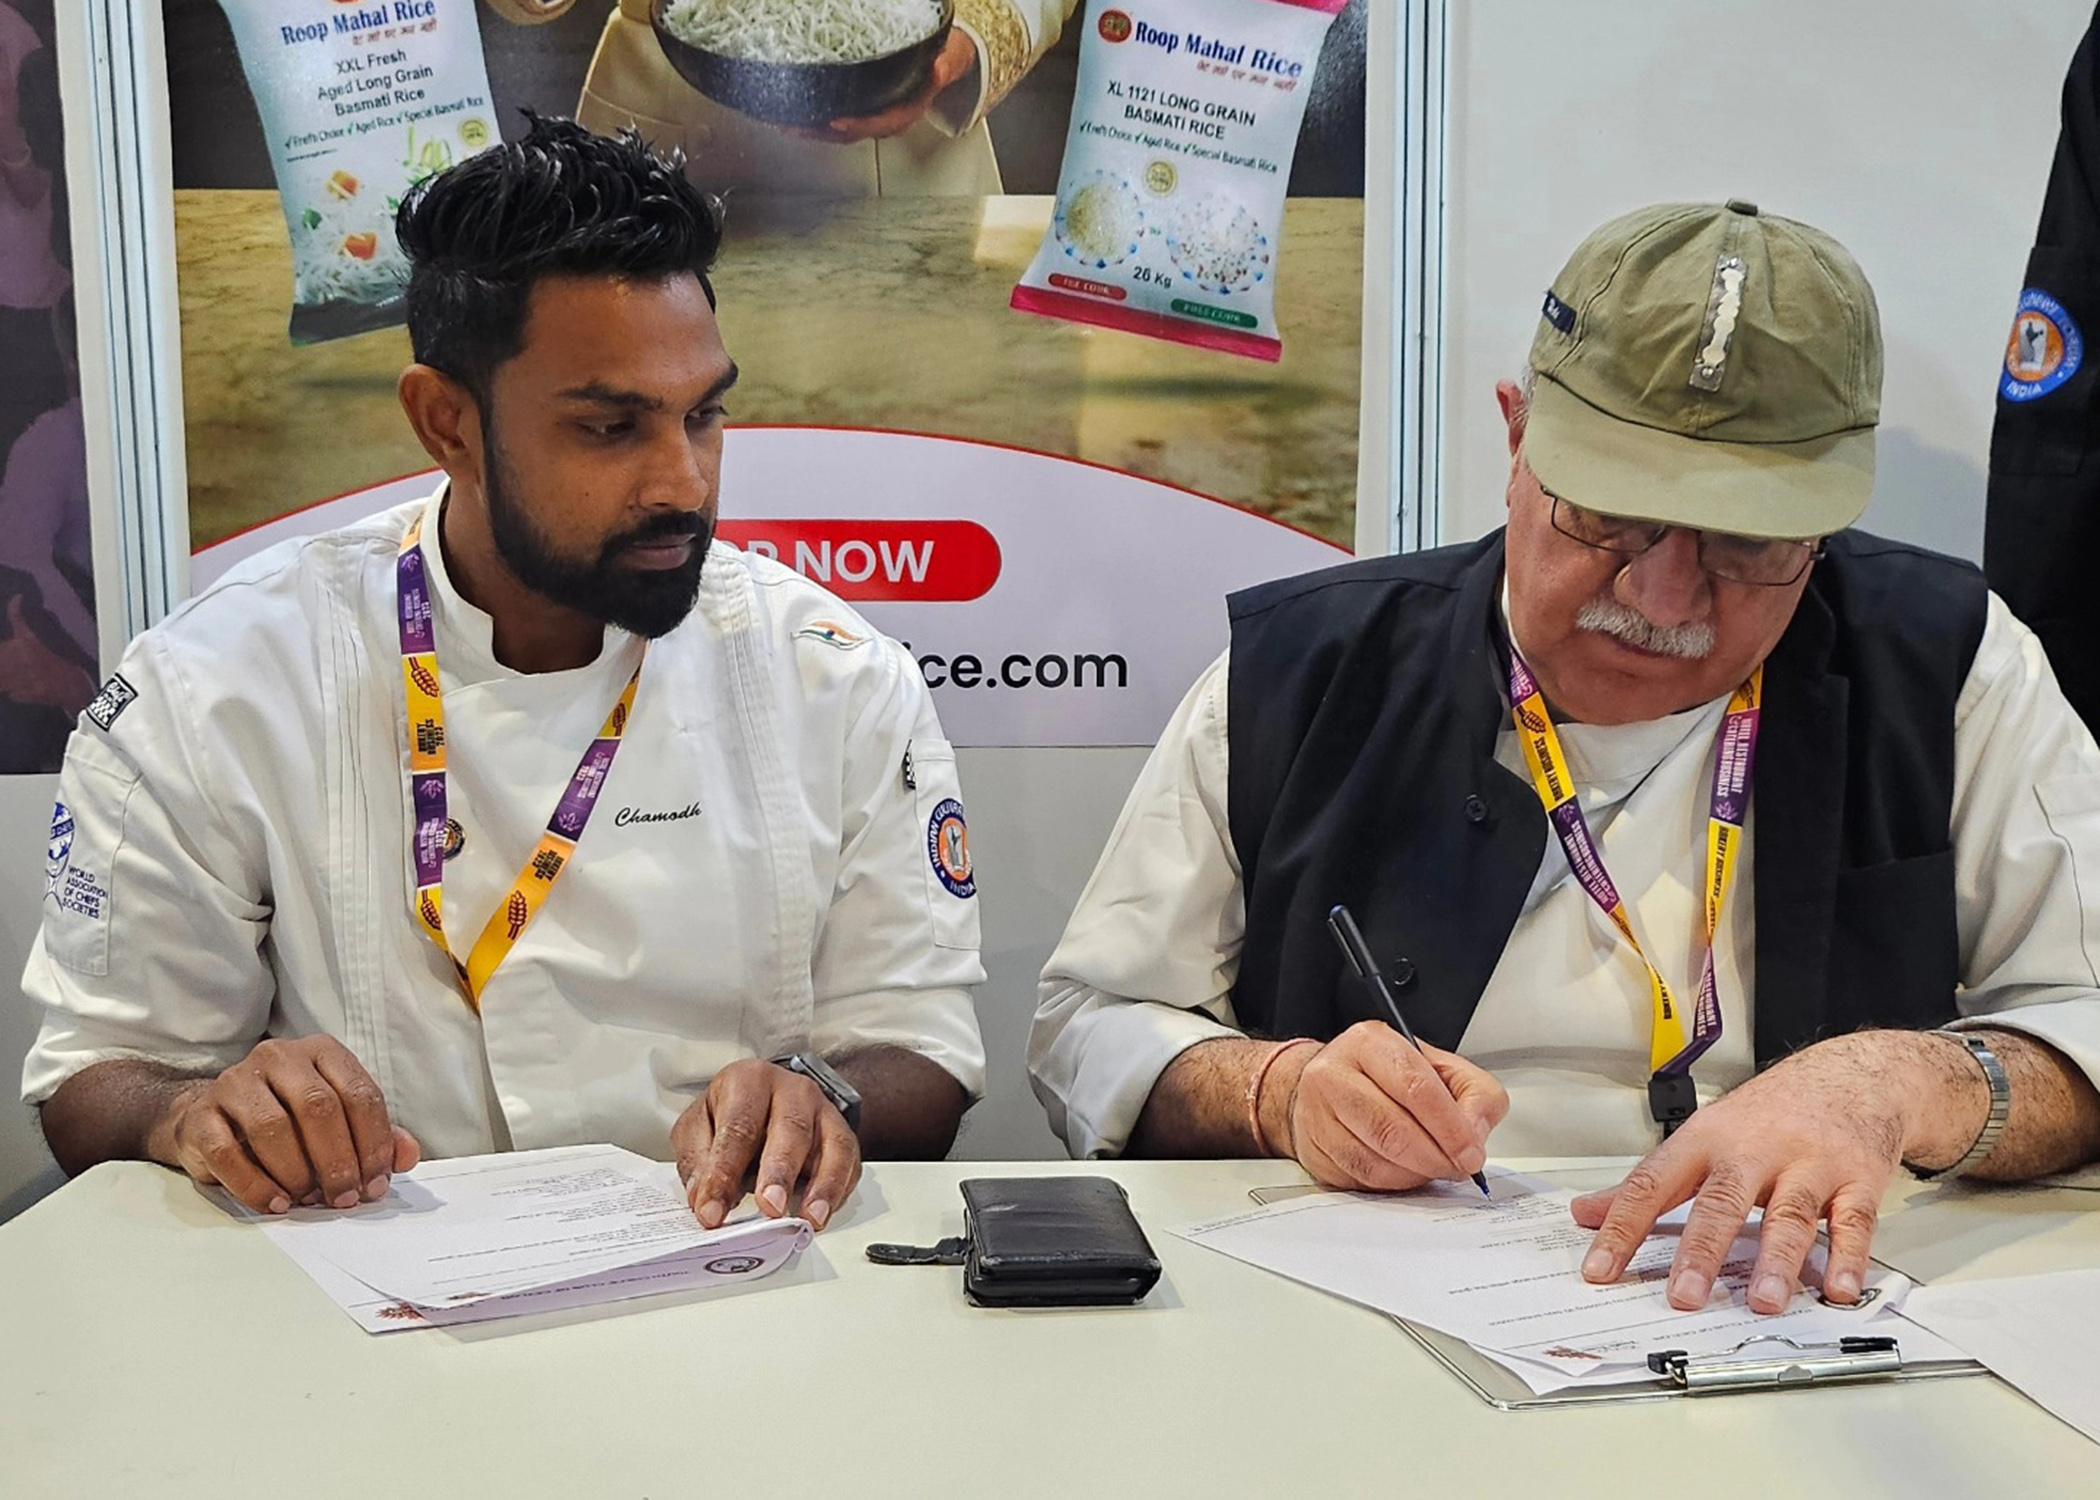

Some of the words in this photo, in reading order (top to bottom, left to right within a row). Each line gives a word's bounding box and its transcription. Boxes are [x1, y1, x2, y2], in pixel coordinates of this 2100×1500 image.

[281, 21, 328, 46] Roop
[333, 5, 388, 36] Mahal
[395, 0, 436, 23] Rice
[336, 57, 364, 75] XXL
[367, 50, 407, 69] Fresh
[1135, 21, 1179, 53] Roop
[1185, 33, 1245, 65] Mahal
[1251, 48, 1303, 78] Rice
[317, 82, 353, 101] Aged
[356, 73, 392, 93] Long
[395, 65, 433, 84] Grain
[335, 93, 391, 116] Basmati
[395, 87, 425, 104] Rice
[1107, 80, 1123, 97] XL
[1128, 85, 1155, 104] 1121
[1160, 91, 1200, 114] LONG
[1204, 103, 1256, 126] GRAIN
[1124, 104, 1186, 132] BASMATI
[1189, 120, 1226, 140] RICE
[1154, 273, 1172, 288] Kg
[795, 540, 934, 582] NOW
[902, 641, 1127, 688] ce.com
[1534, 736, 1555, 774] BUSINESS
[1730, 742, 1749, 794] RESTAURANT
[1547, 773, 1564, 803] BAKERY
[615, 802, 702, 827] Chamodh
[1564, 835, 1593, 883] RESTAURANT
[1719, 826, 1729, 858] BAKERY
[64, 887, 74, 897] OF
[66, 877, 109, 900] ASSOCIATION
[69, 865, 95, 883] WORLD
[1713, 857, 1725, 898] BUSINESS
[62, 897, 99, 919] SOCIETIES
